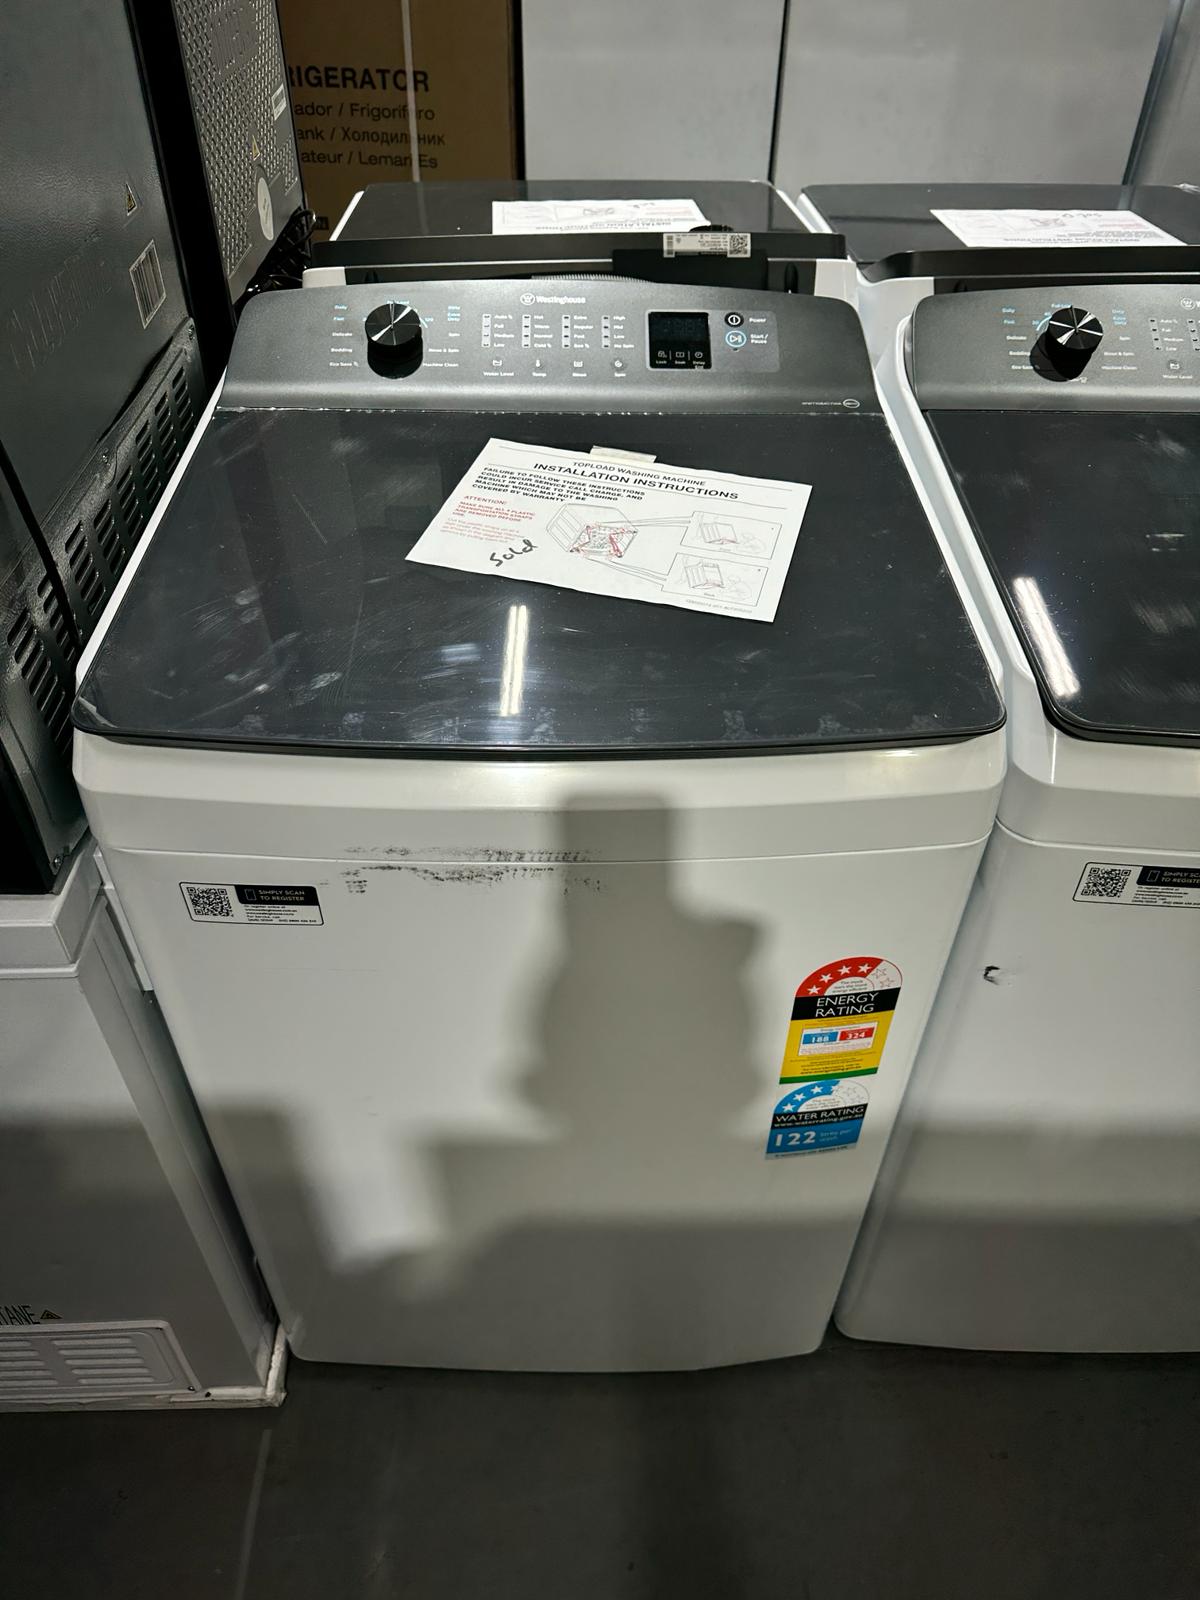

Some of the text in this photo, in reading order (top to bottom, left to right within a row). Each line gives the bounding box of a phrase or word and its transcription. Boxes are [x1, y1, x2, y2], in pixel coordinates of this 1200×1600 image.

[350, 103, 435, 121] Frigorífro
[341, 126, 446, 146] Холодилник
[536, 295, 586, 305] Westinghouse
[484, 467, 515, 475] FAILURE
[529, 474, 560, 482] FOLLOW
[588, 484, 645, 496] INSTRUCTIONS
[533, 463, 739, 500] INSTALLATION INSTRUCTIONS
[573, 462, 707, 486] TOPLOAD WASHING MACHINE
[472, 484, 509, 493] COVERED
[522, 492, 566, 502] WARRANTY
[475, 479, 510, 488] MACHINE
[512, 485, 538, 493] WHICH
[478, 475, 507, 483] RESULT
[518, 481, 551, 490] DAMAGE
[583, 492, 618, 501] WASHING
[534, 480, 567, 489] SERVICE
[489, 538, 539, 567] Sold
[816, 992, 879, 1007] ENERGY
[815, 1003, 875, 1017] RATING
[846, 1031, 865, 1040] 324
[776, 1106, 864, 1122] WATER RATING
[775, 1131, 816, 1147] 122
